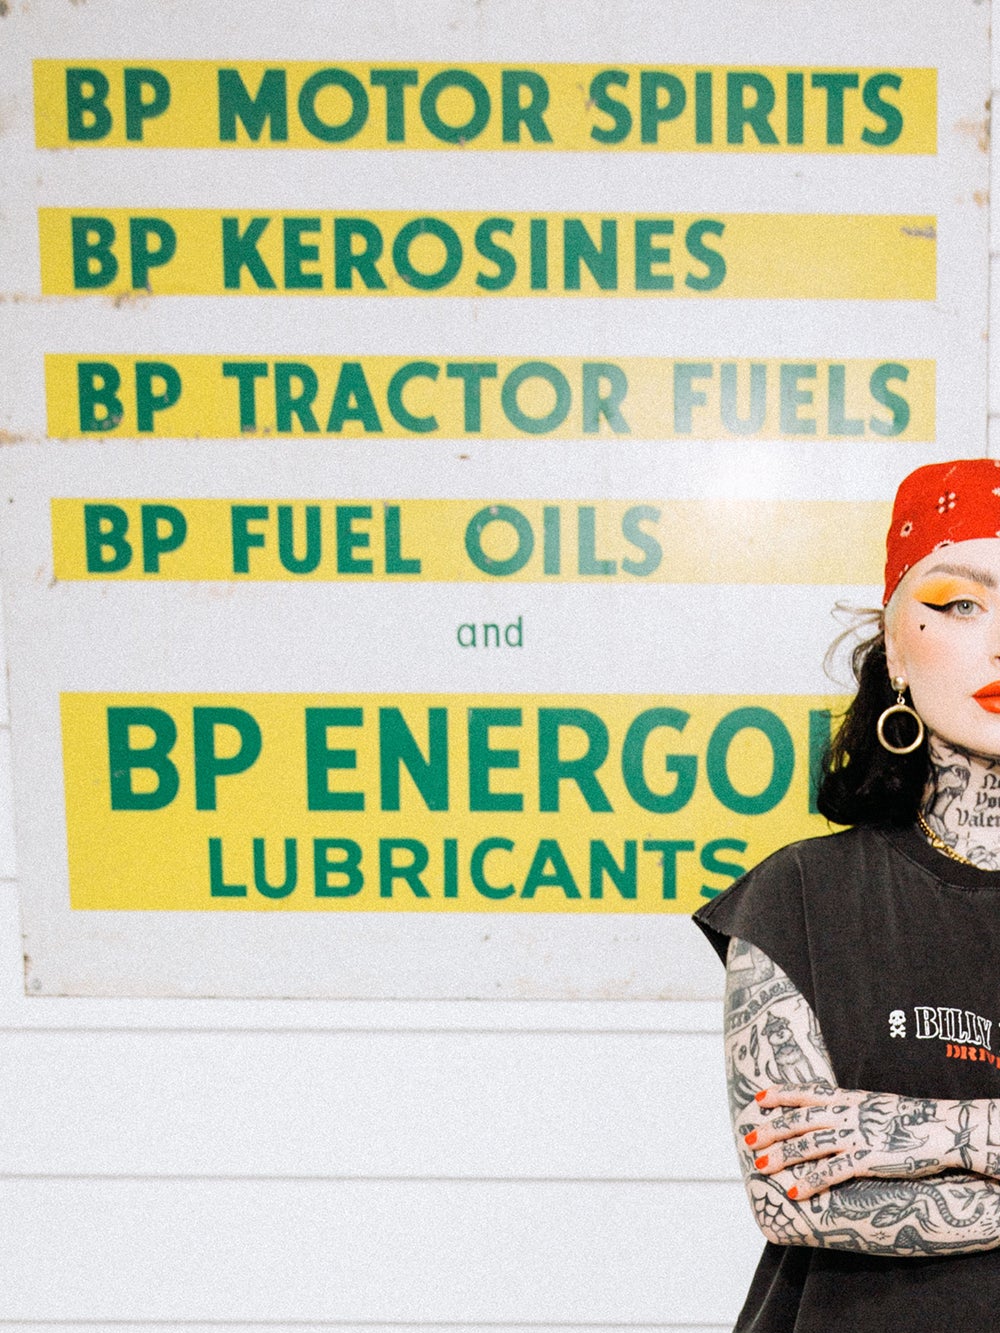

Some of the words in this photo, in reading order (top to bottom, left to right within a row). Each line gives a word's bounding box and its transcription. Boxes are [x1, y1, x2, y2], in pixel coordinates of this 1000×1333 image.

[65, 67, 172, 141] BP
[217, 67, 554, 144] MOTOR
[589, 69, 905, 147] SPIRITS
[71, 216, 178, 289] BP
[221, 216, 728, 291] KEROSINES
[77, 361, 183, 433] BP
[222, 361, 632, 436] TRACTOR
[673, 363, 911, 437] FUELS
[83, 503, 188, 574] BP
[230, 504, 422, 575] FUEL
[464, 505, 664, 577] OILS
[456, 615, 524, 648] and
[106, 706, 263, 812] BP
[207, 837, 748, 901] LUBRICANTS
[914, 1006, 992, 1051] BILLY
